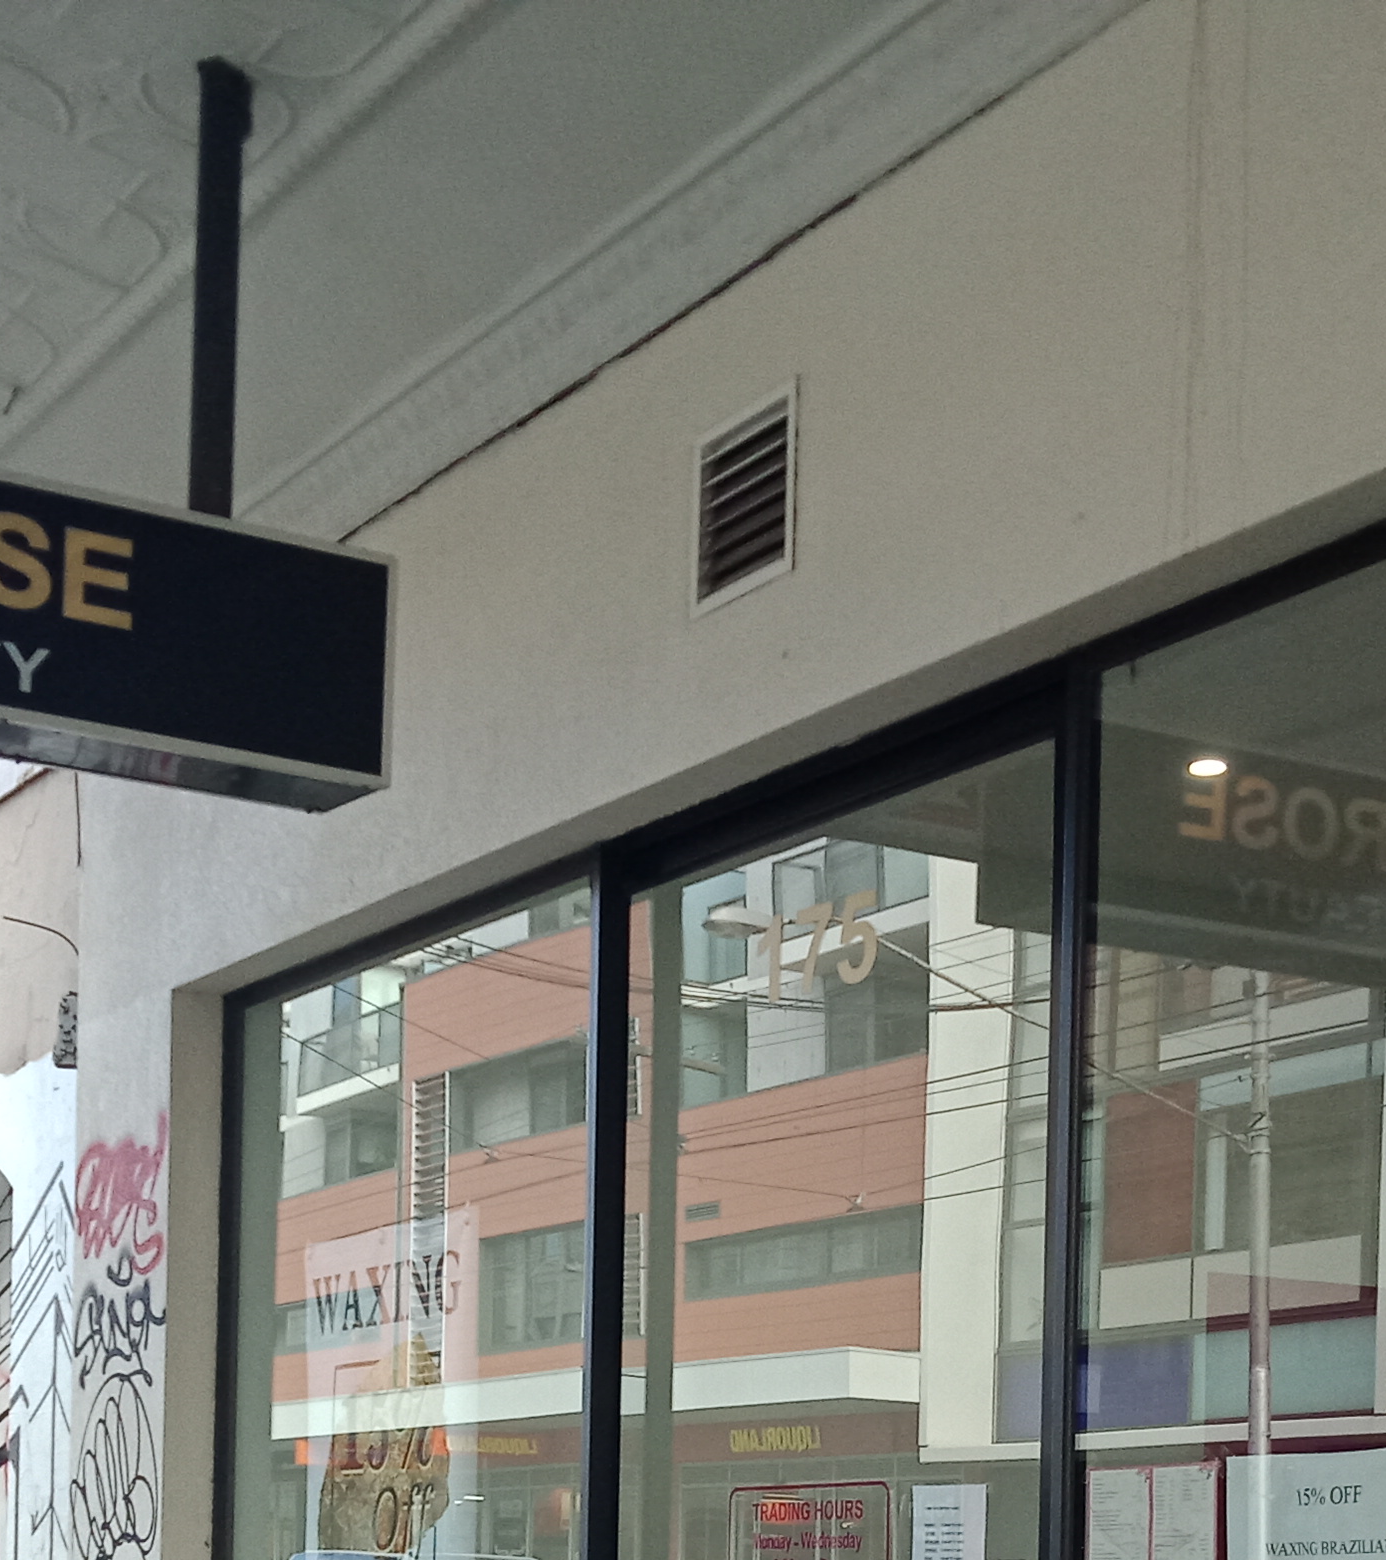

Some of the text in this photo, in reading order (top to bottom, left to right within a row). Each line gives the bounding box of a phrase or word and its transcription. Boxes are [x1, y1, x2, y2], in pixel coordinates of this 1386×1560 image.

[757, 889, 879, 1004] 175
[313, 1250, 462, 1336] WAXING
[1296, 1485, 1363, 1506] 15% OFF
[374, 1482, 435, 1560] Off
[752, 1500, 864, 1522] TRADING HOURS
[753, 1532, 793, 1552] Monday
[801, 1531, 863, 1553] Wednesday
[1265, 1541, 1318, 1556] WAXING
